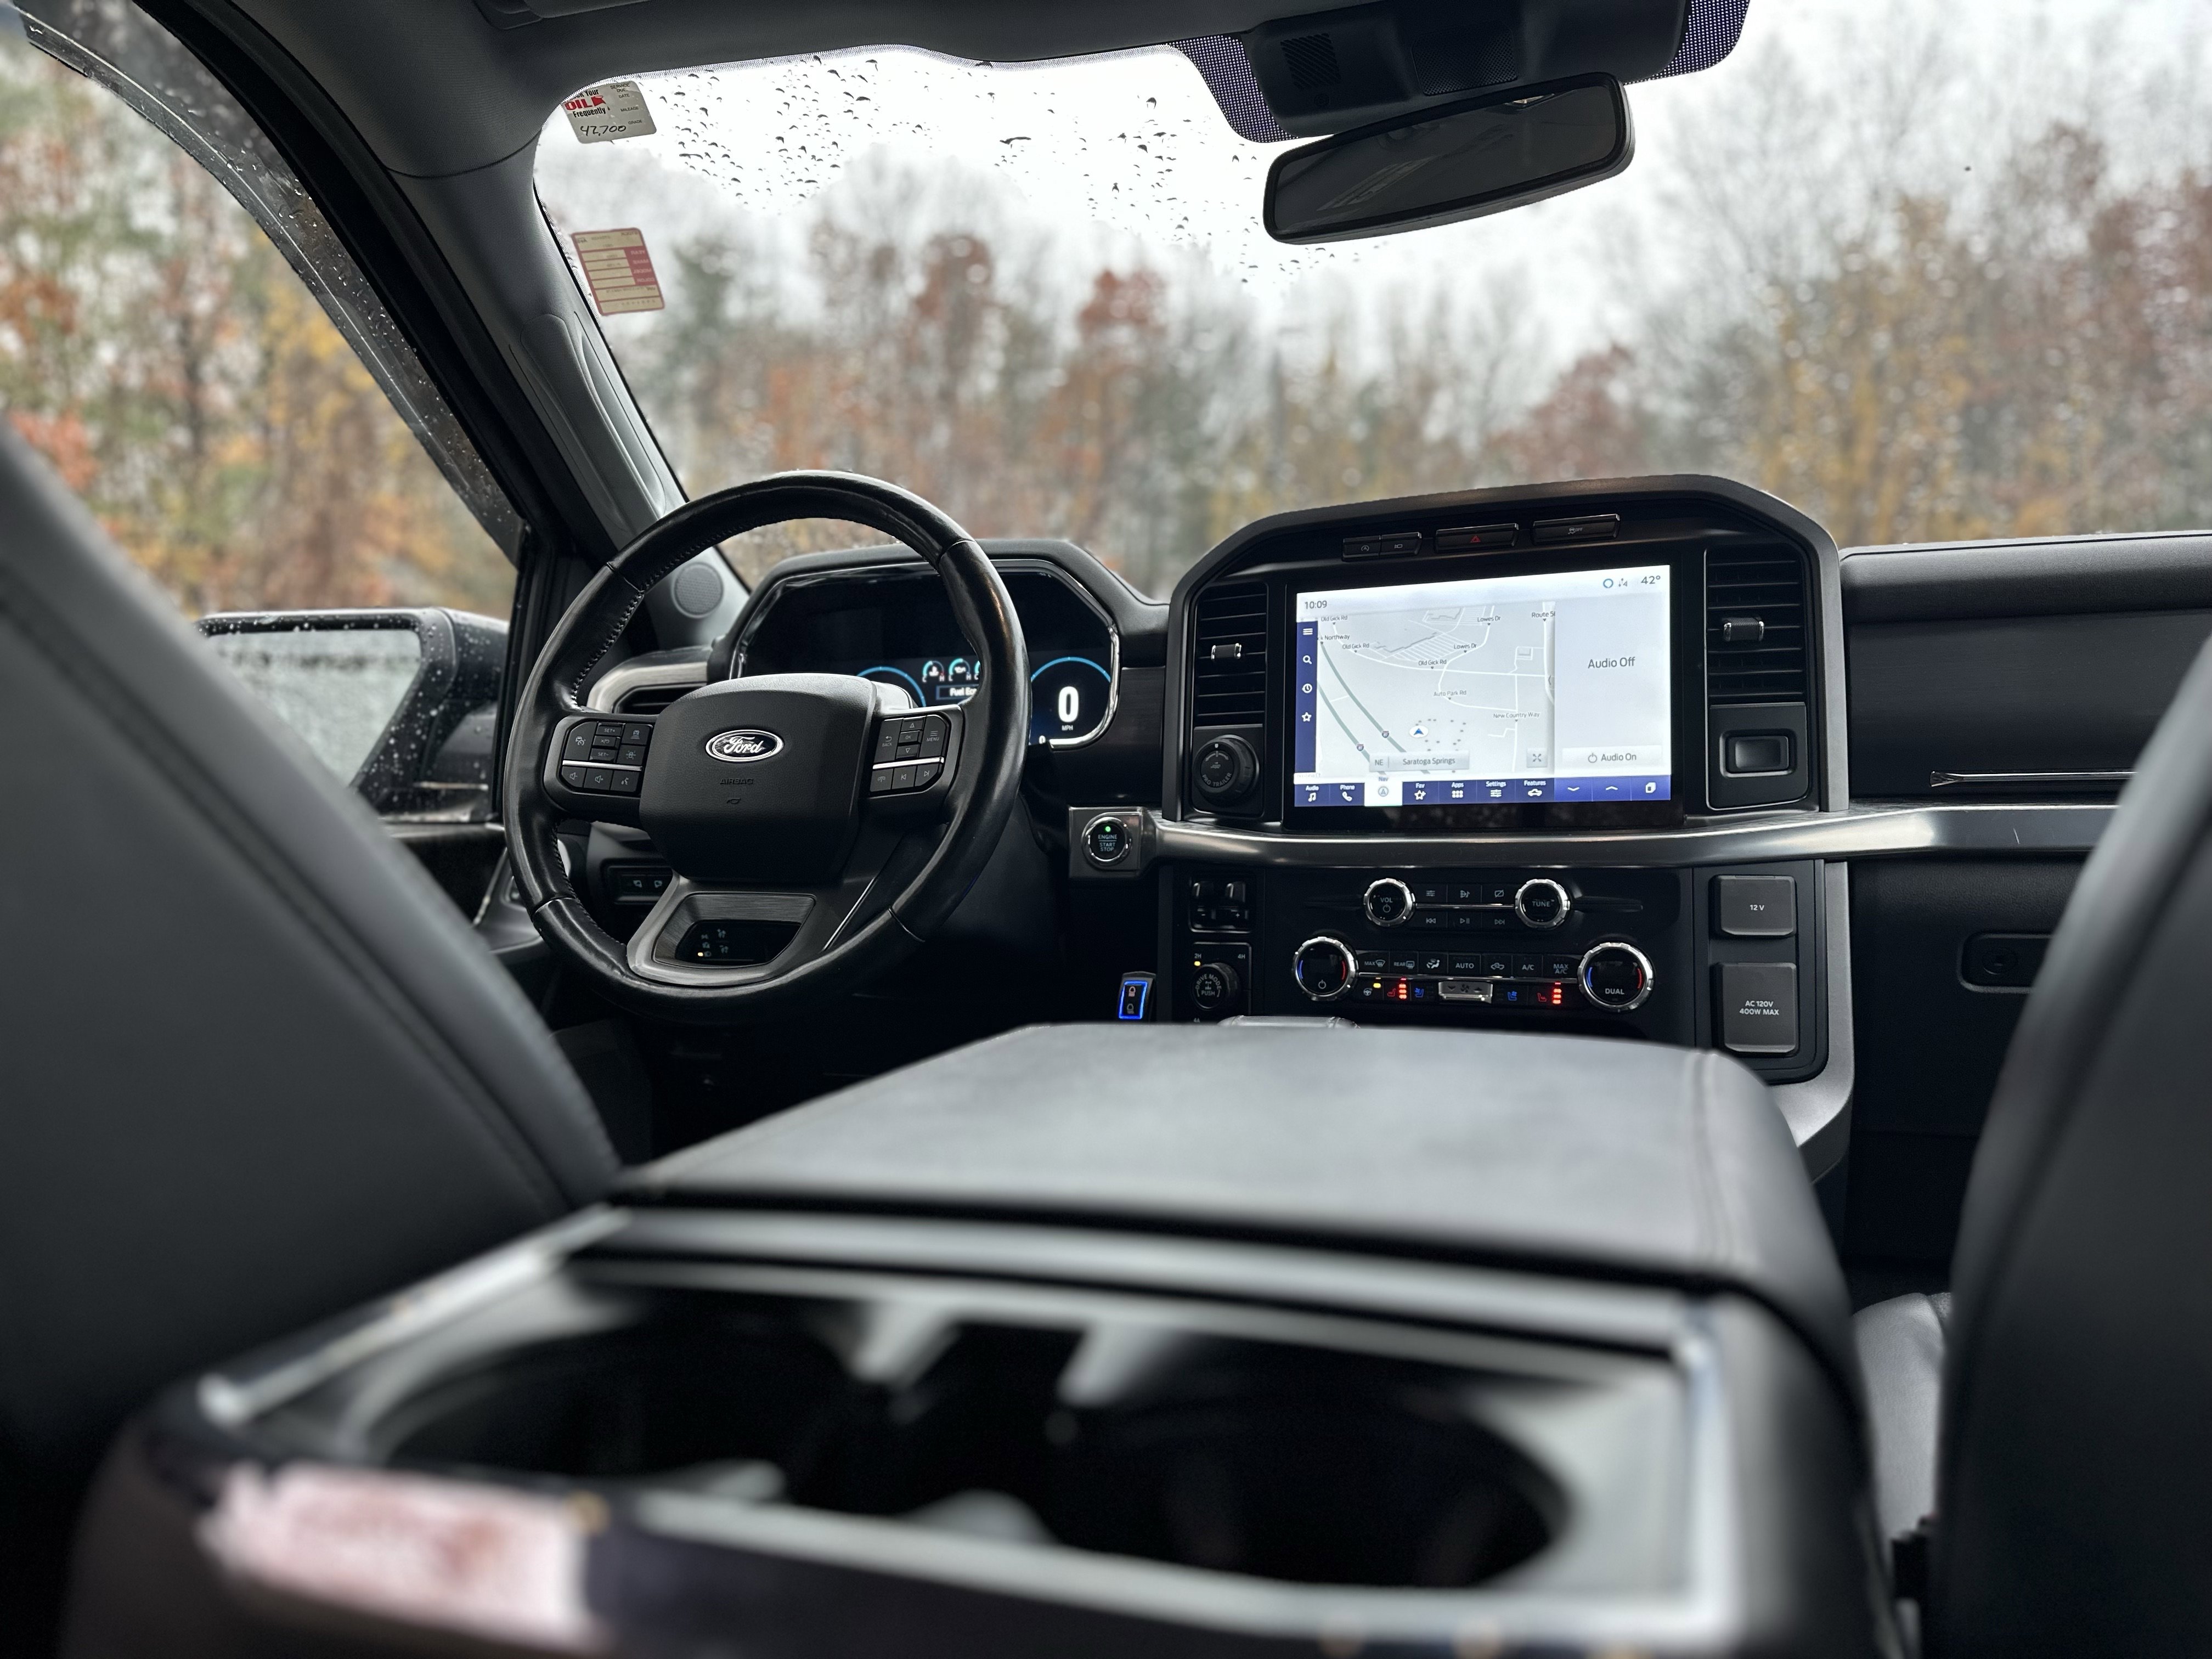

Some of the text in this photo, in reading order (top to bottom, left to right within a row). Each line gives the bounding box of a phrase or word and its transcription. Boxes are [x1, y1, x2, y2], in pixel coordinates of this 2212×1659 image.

[564, 98, 593, 111] OIL
[573, 107, 606, 118] Frequently
[580, 125, 627, 136] 42,700
[1304, 600, 1328, 610] 10:09
[1588, 656, 1635, 669] Audio Off
[950, 687, 964, 697] Fuel
[1058, 686, 1080, 723] 0
[723, 736, 764, 753] Ford
[1403, 757, 1455, 766] Saratoga Springs
[1601, 753, 1637, 761] Audio On
[1202, 772, 1232, 787] PRO TRAILER
[1195, 974, 1222, 990] DRIVE MODE
